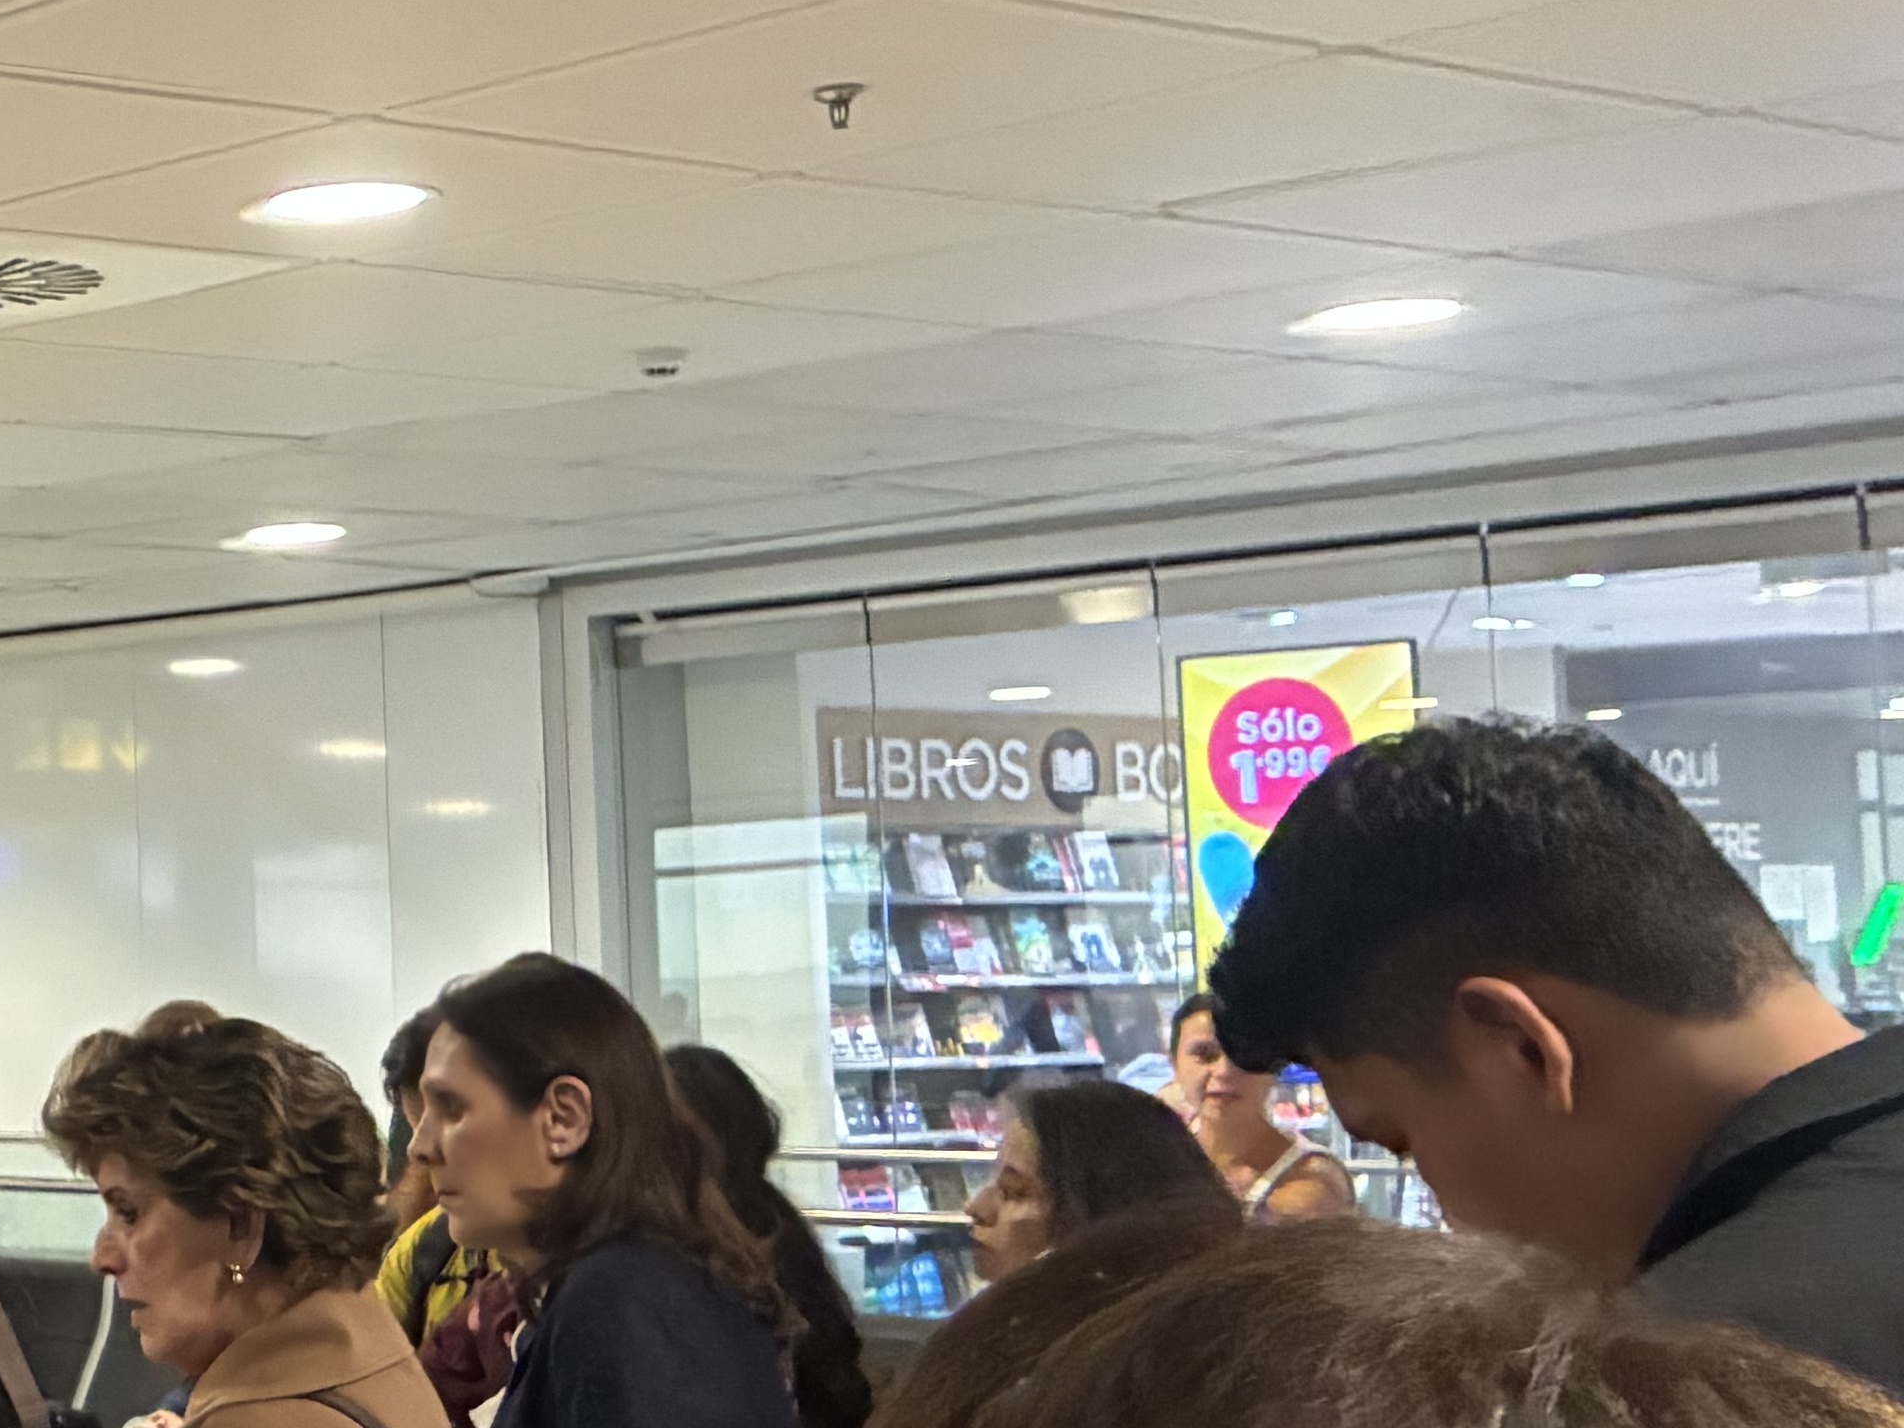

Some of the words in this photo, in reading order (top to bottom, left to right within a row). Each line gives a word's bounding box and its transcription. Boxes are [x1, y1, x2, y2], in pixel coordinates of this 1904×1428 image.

[1236, 707, 1323, 744] Sólo
[832, 736, 1031, 802] LIBROS
[1648, 742, 1720, 787] AQUÍ
